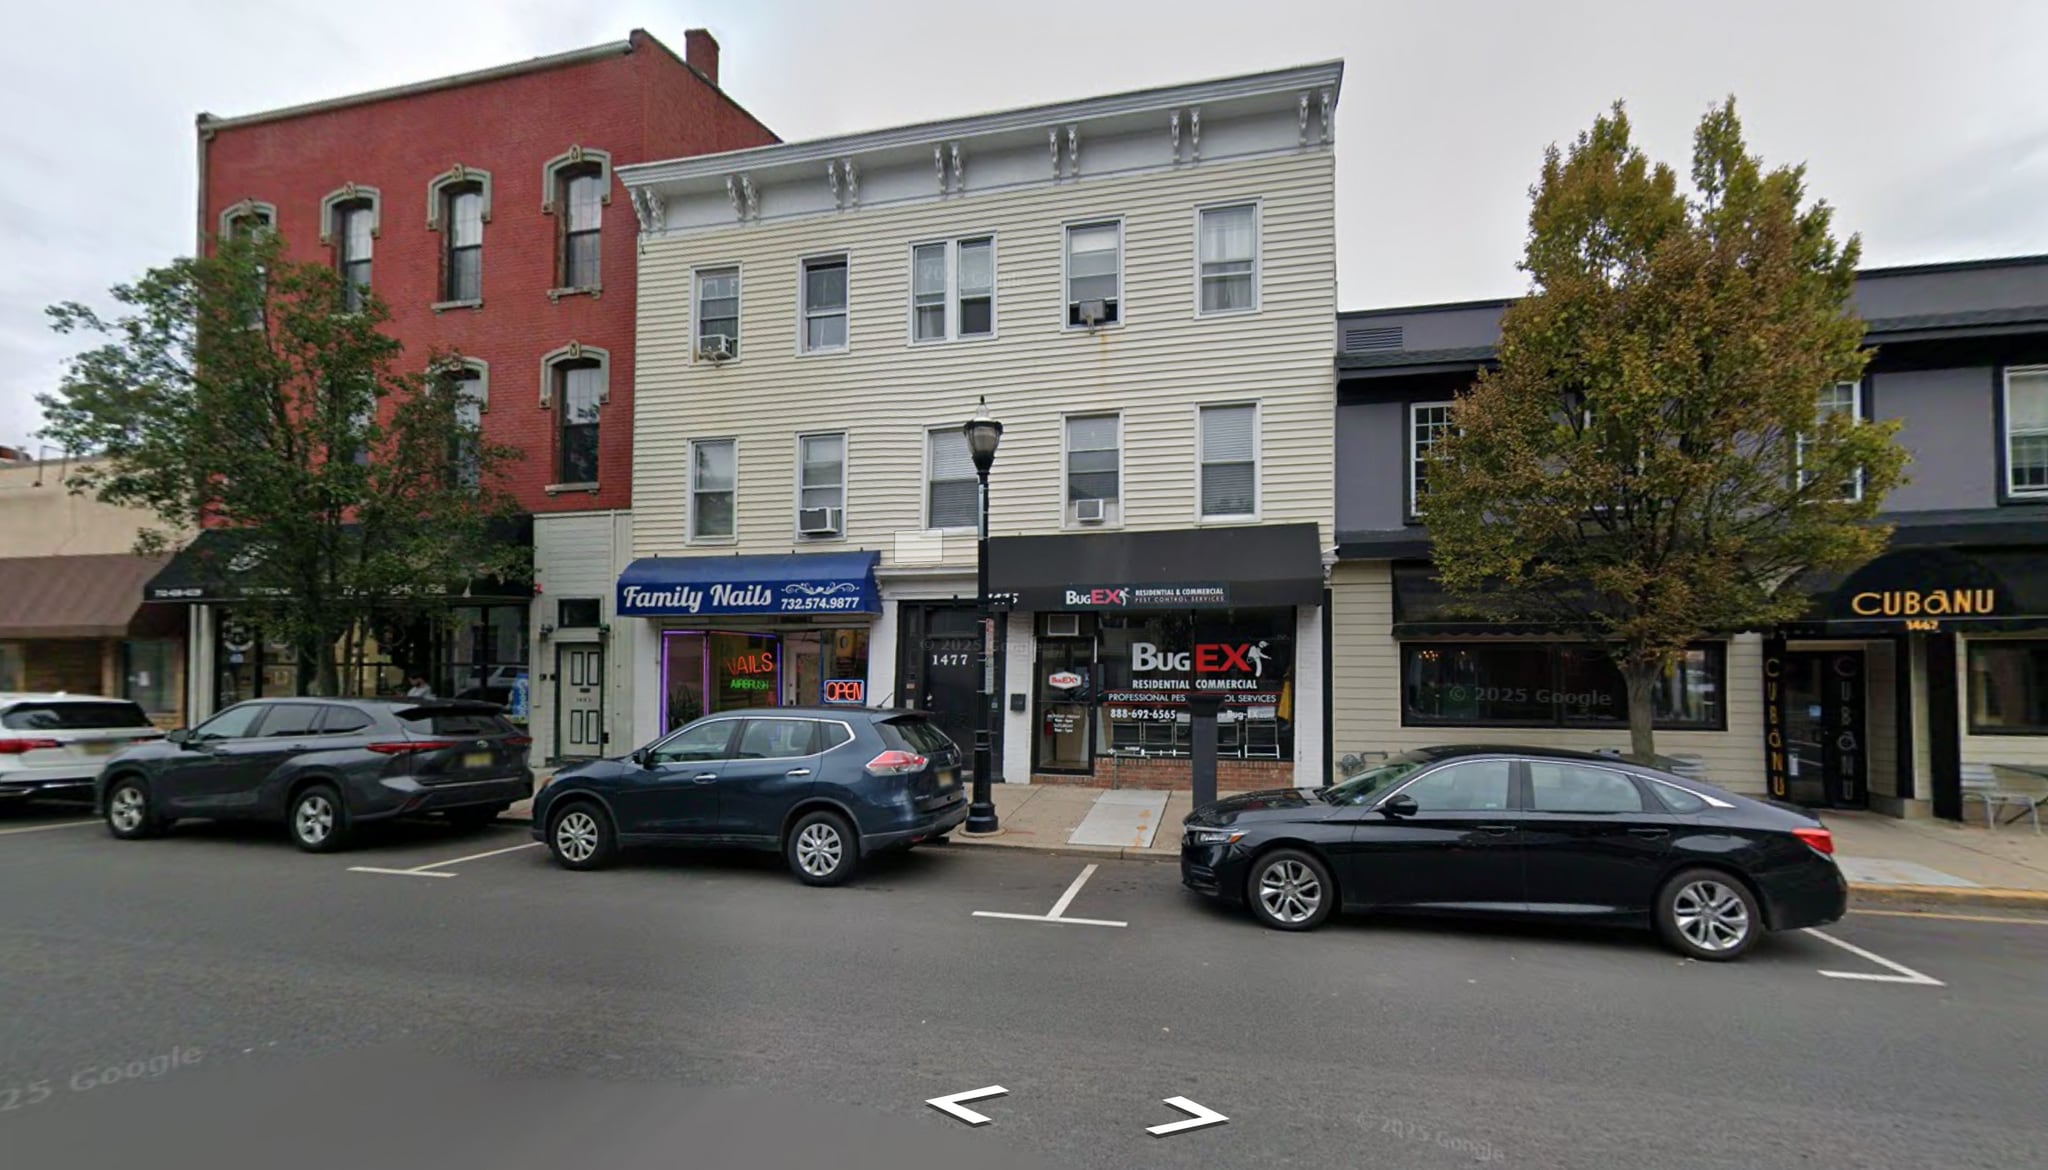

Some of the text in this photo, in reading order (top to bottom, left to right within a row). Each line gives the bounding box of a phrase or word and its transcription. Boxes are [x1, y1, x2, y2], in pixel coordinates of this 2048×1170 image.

[623, 584, 772, 613] Family Nails
[780, 597, 859, 610] 732.574.9877
[932, 654, 968, 666] 1477
[730, 679, 769, 690] AIRBRUSH
[1132, 680, 1258, 689] RESIDENTIAL COMMERCIAL
[826, 682, 862, 701] OPEN
[1108, 694, 1169, 702] PROFESSIONAL
[1238, 695, 1277, 703] SERVICES
[1110, 709, 1176, 719] 888-692-6565
